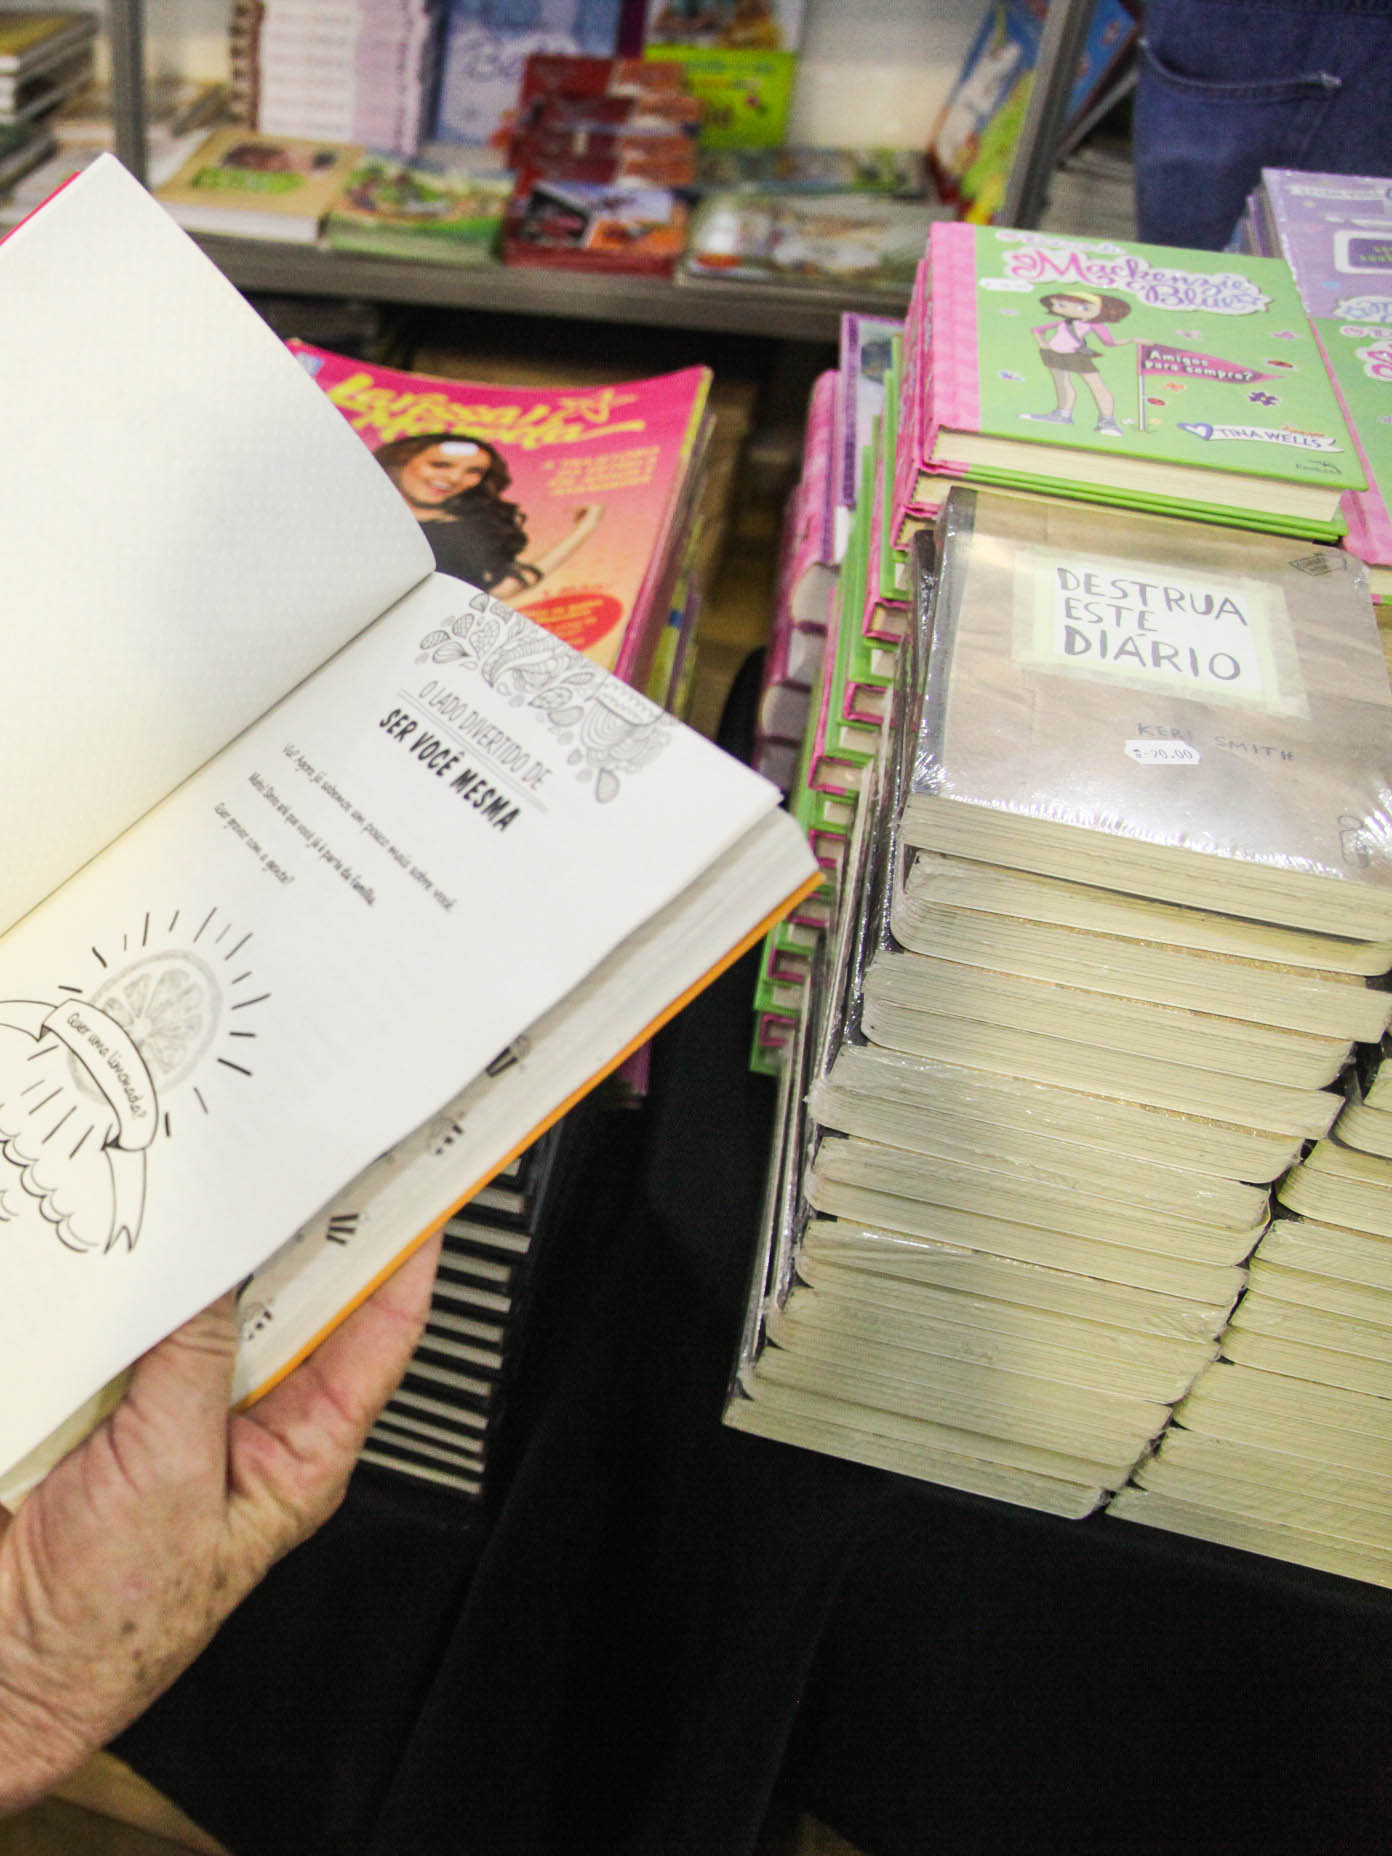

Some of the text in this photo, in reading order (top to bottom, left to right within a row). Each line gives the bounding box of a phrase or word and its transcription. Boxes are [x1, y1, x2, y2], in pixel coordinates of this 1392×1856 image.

[1185, 362, 1254, 383] sempre?
[1263, 430, 1324, 449] WELLS
[1057, 567, 1248, 626] DESTRUA
[1064, 597, 1158, 632] ESTE
[1064, 624, 1241, 681] DIÁRIO
[419, 680, 553, 791] O LADO DIVERTIDO DE
[1213, 736, 1296, 761] SMITH
[379, 708, 520, 831] SER VOCÊ MESMA
[67, 1012, 147, 1119] Quer uma limonada?
